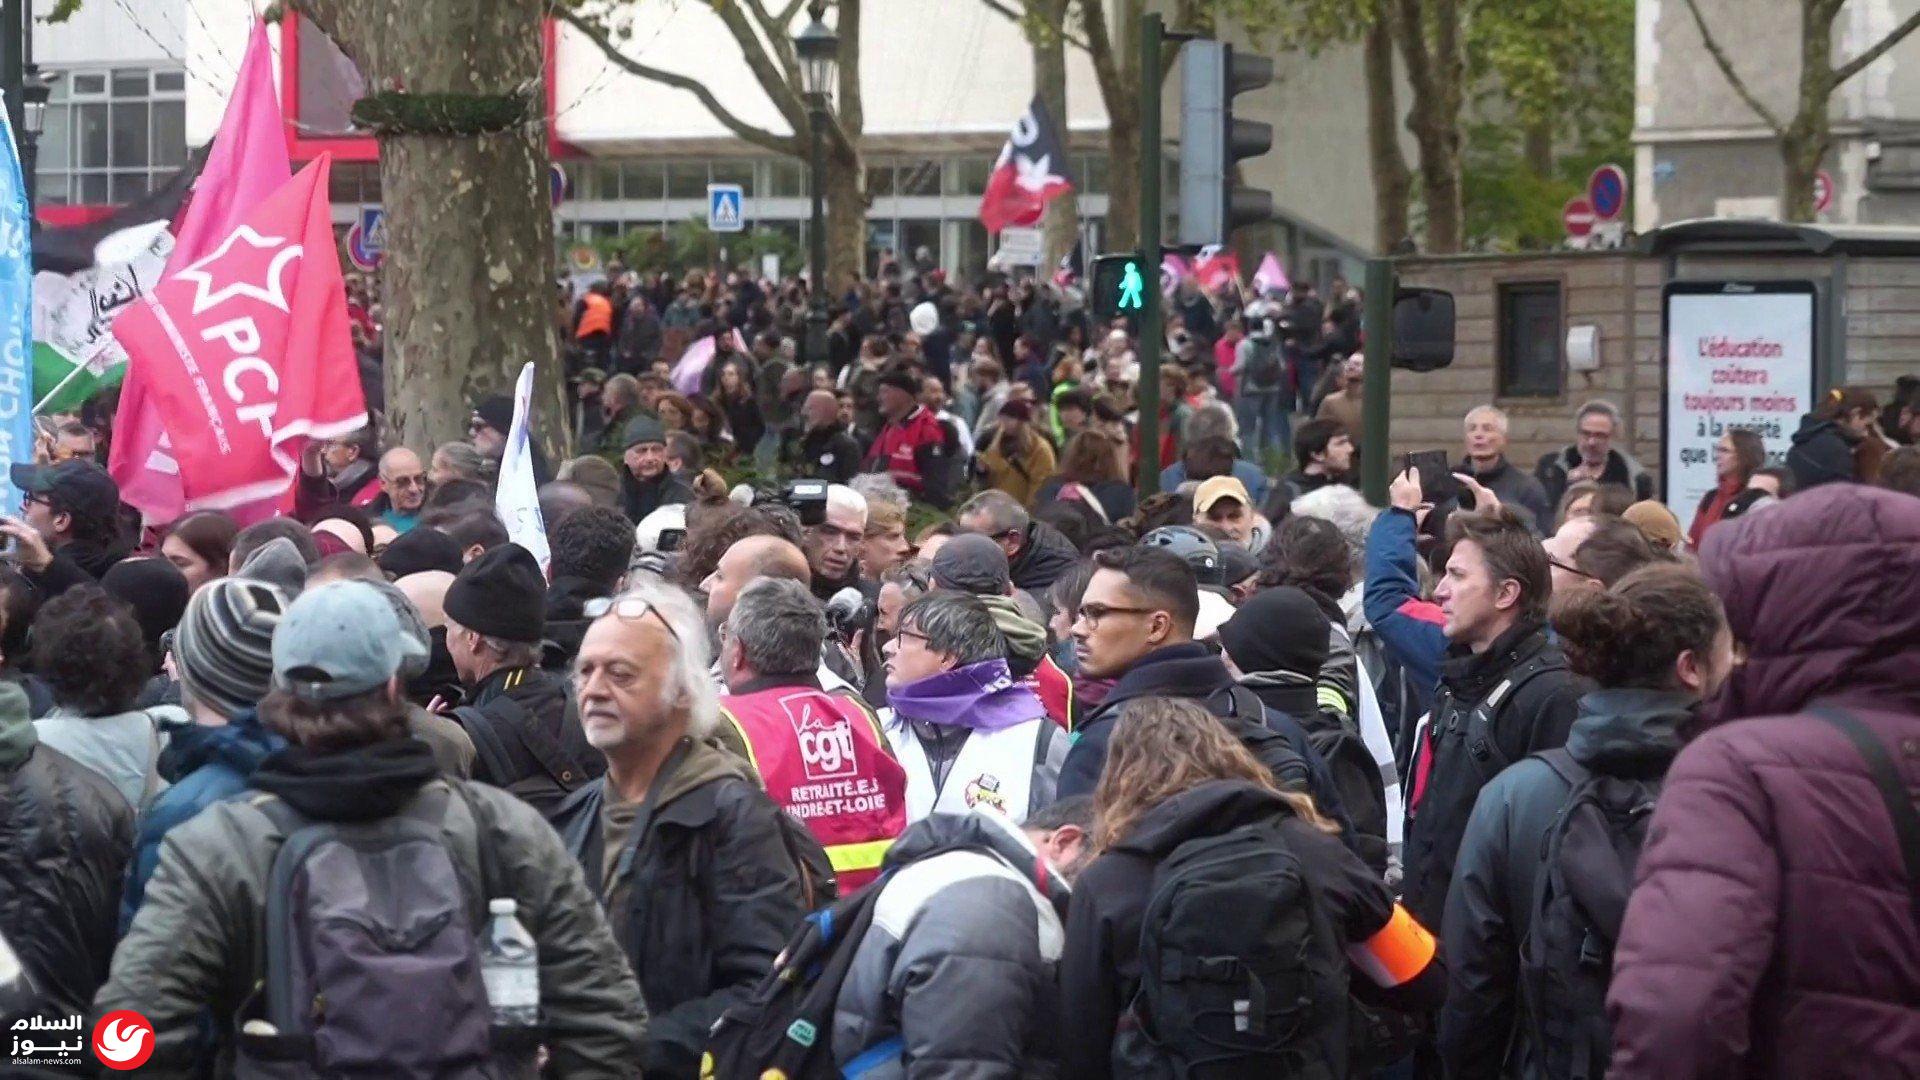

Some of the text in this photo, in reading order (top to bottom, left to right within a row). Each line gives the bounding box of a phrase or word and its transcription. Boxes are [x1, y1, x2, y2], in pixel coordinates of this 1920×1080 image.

[1698, 335, 1783, 358] L'éducation
[1712, 363, 1768, 384] coûtera
[1684, 390, 1797, 414] toujours moins
[1697, 415, 1706, 437] à
[1710, 415, 1723, 437] la
[1679, 447, 1708, 468] que
[799, 721, 852, 772] cgt
